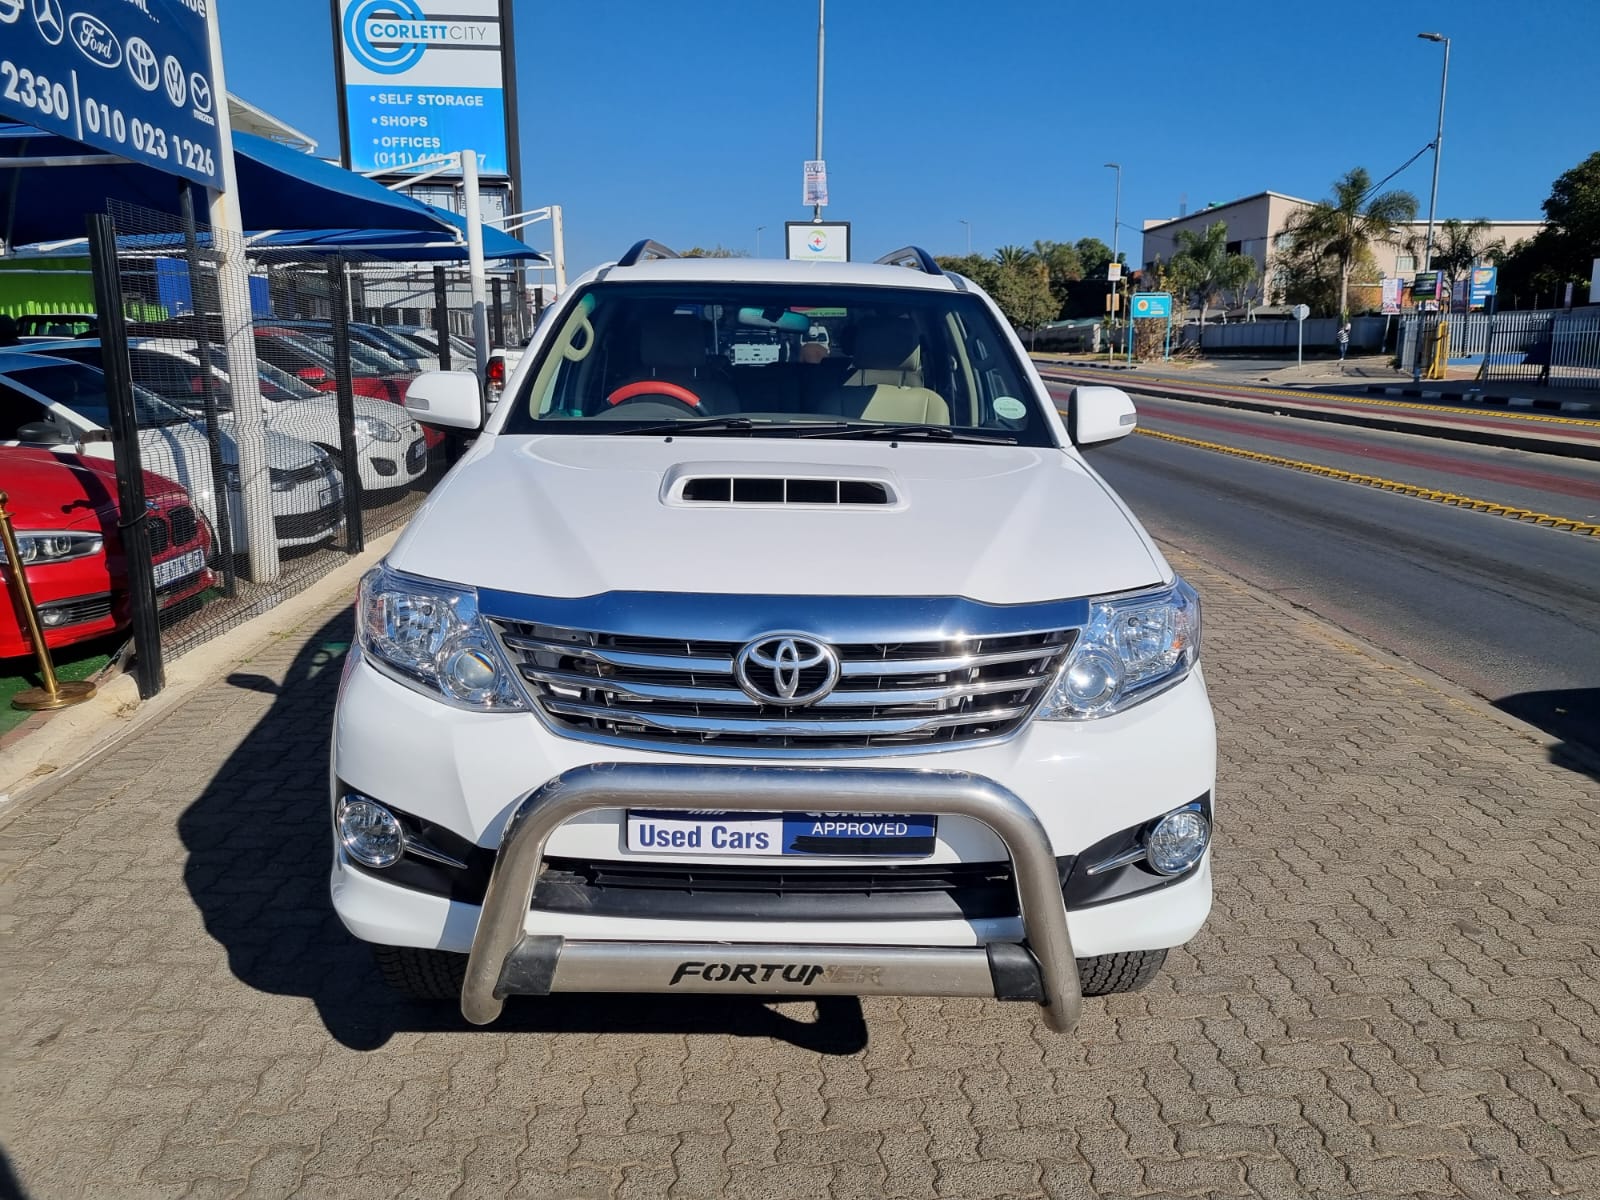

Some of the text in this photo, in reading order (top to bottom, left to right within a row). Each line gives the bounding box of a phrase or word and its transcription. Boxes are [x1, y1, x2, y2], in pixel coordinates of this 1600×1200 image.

[79, 20, 112, 59] Ford
[370, 23, 486, 40] CORLETT CITY
[379, 93, 484, 106] SELF STORAGE
[1, 60, 215, 177] 2330 010 023 1226
[380, 115, 428, 127] SHOPS
[381, 137, 441, 148] OFFICES
[374, 152, 412, 168] (011)
[639, 823, 770, 849] Used Cars
[812, 822, 907, 836] APPROVED
[669, 961, 883, 986] FORTUNER
